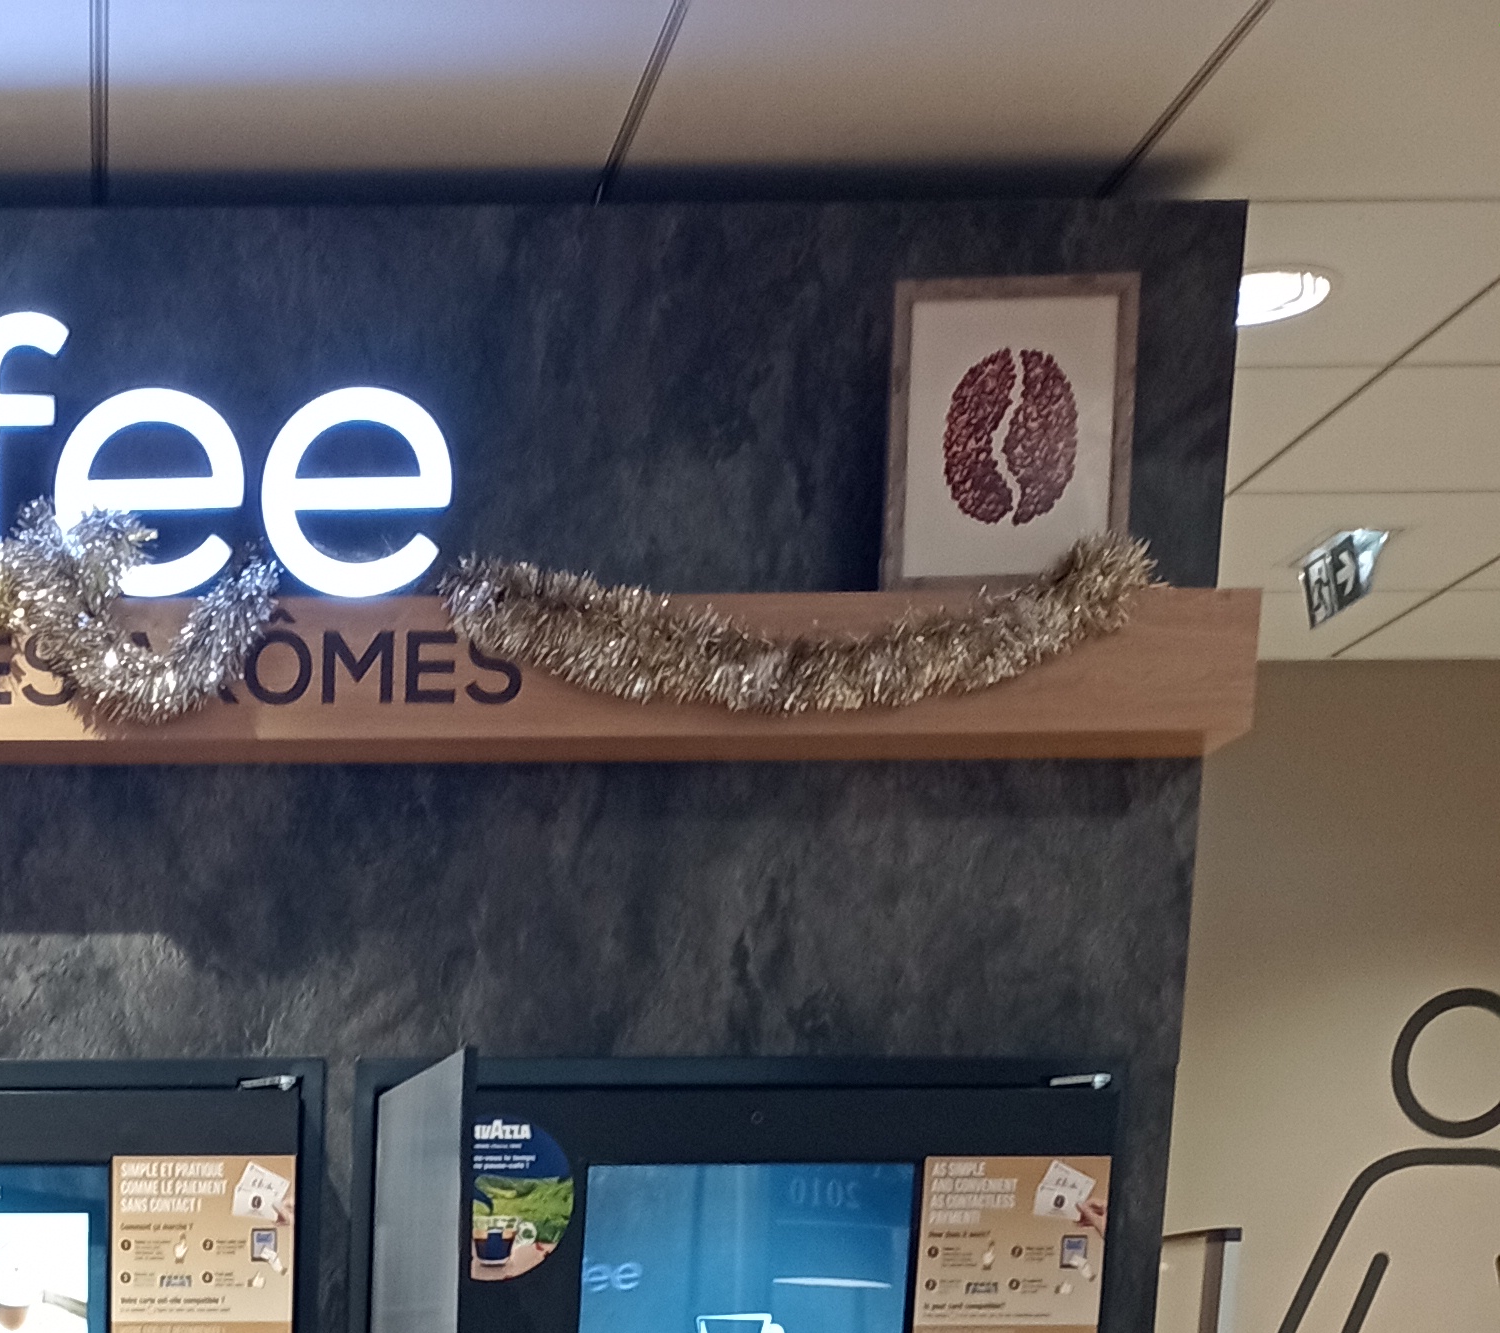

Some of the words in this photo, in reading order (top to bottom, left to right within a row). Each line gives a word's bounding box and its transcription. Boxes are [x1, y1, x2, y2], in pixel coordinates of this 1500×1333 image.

[120, 1162, 158, 1178] SIMPLE
[160, 1162, 173, 1178] ET
[175, 1162, 224, 1178] PRATIQUE
[120, 1179, 160, 1195] COMME
[161, 1179, 174, 1195] LE
[175, 1179, 227, 1195] PAIEMENT
[120, 1199, 147, 1213] SANS
[149, 1199, 196, 1213] CONTACT
